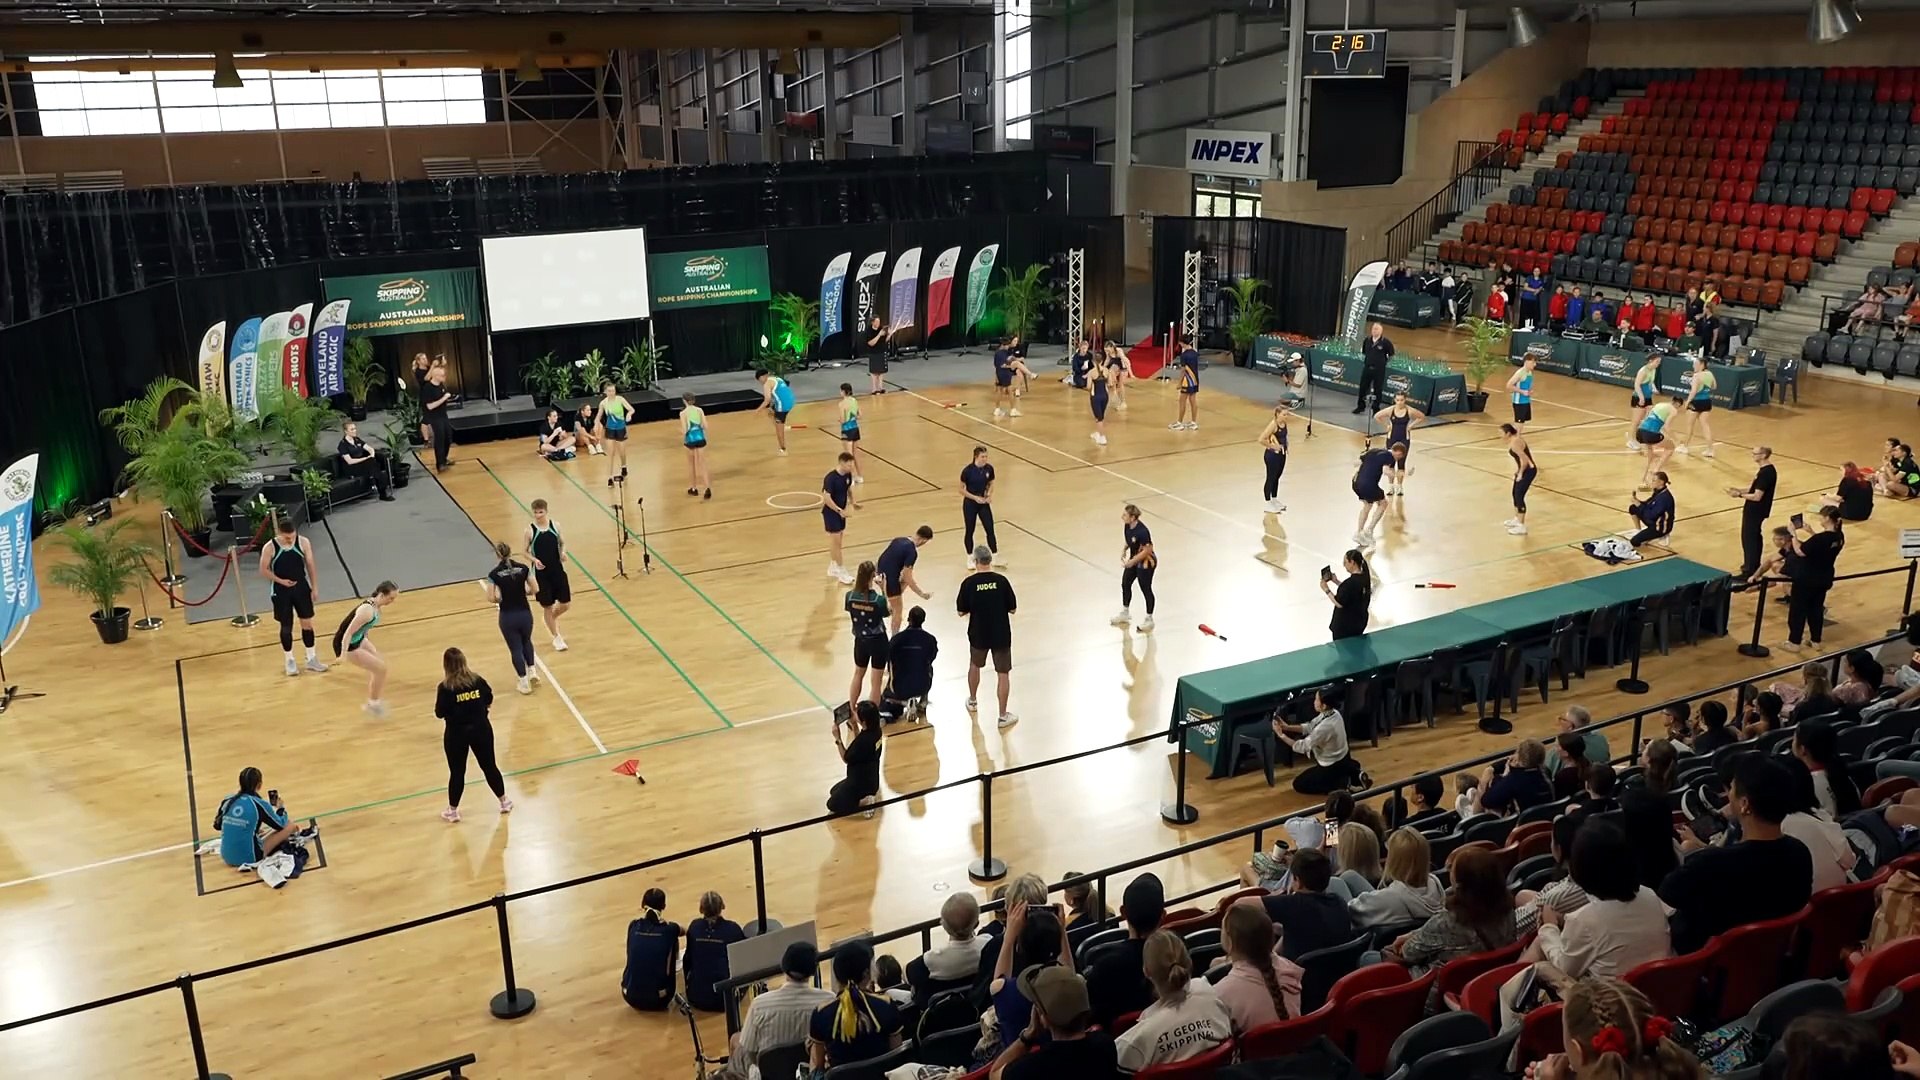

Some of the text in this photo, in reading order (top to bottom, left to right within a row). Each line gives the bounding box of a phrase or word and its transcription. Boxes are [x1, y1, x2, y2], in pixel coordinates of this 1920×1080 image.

[1332, 35, 1364, 49] 2:16
[1191, 139, 1264, 164] INPEX
[684, 263, 720, 273] SKIPPING
[377, 286, 420, 298] SKIPPING
[677, 293, 706, 301] SKIPPING
[706, 288, 758, 299] CHAMPIONSHIPS
[685, 284, 731, 294] AUSTRALIAN
[380, 308, 434, 320] AUSTRALIAN
[858, 280, 870, 332] SKIPZ
[347, 313, 465, 331] ROPE SKIPPING CHAMPIONSHIPS
[291, 344, 299, 377] SHOTS
[328, 336, 339, 371] MAGIC
[318, 331, 328, 397] CLEVELAND
[328, 373, 339, 391] AIR
[0, 525, 17, 604] KATHERINE
[976, 582, 997, 591] JUDGE
[456, 689, 480, 702] JUDGE
[1157, 1019, 1212, 1044] ST GEORGE
